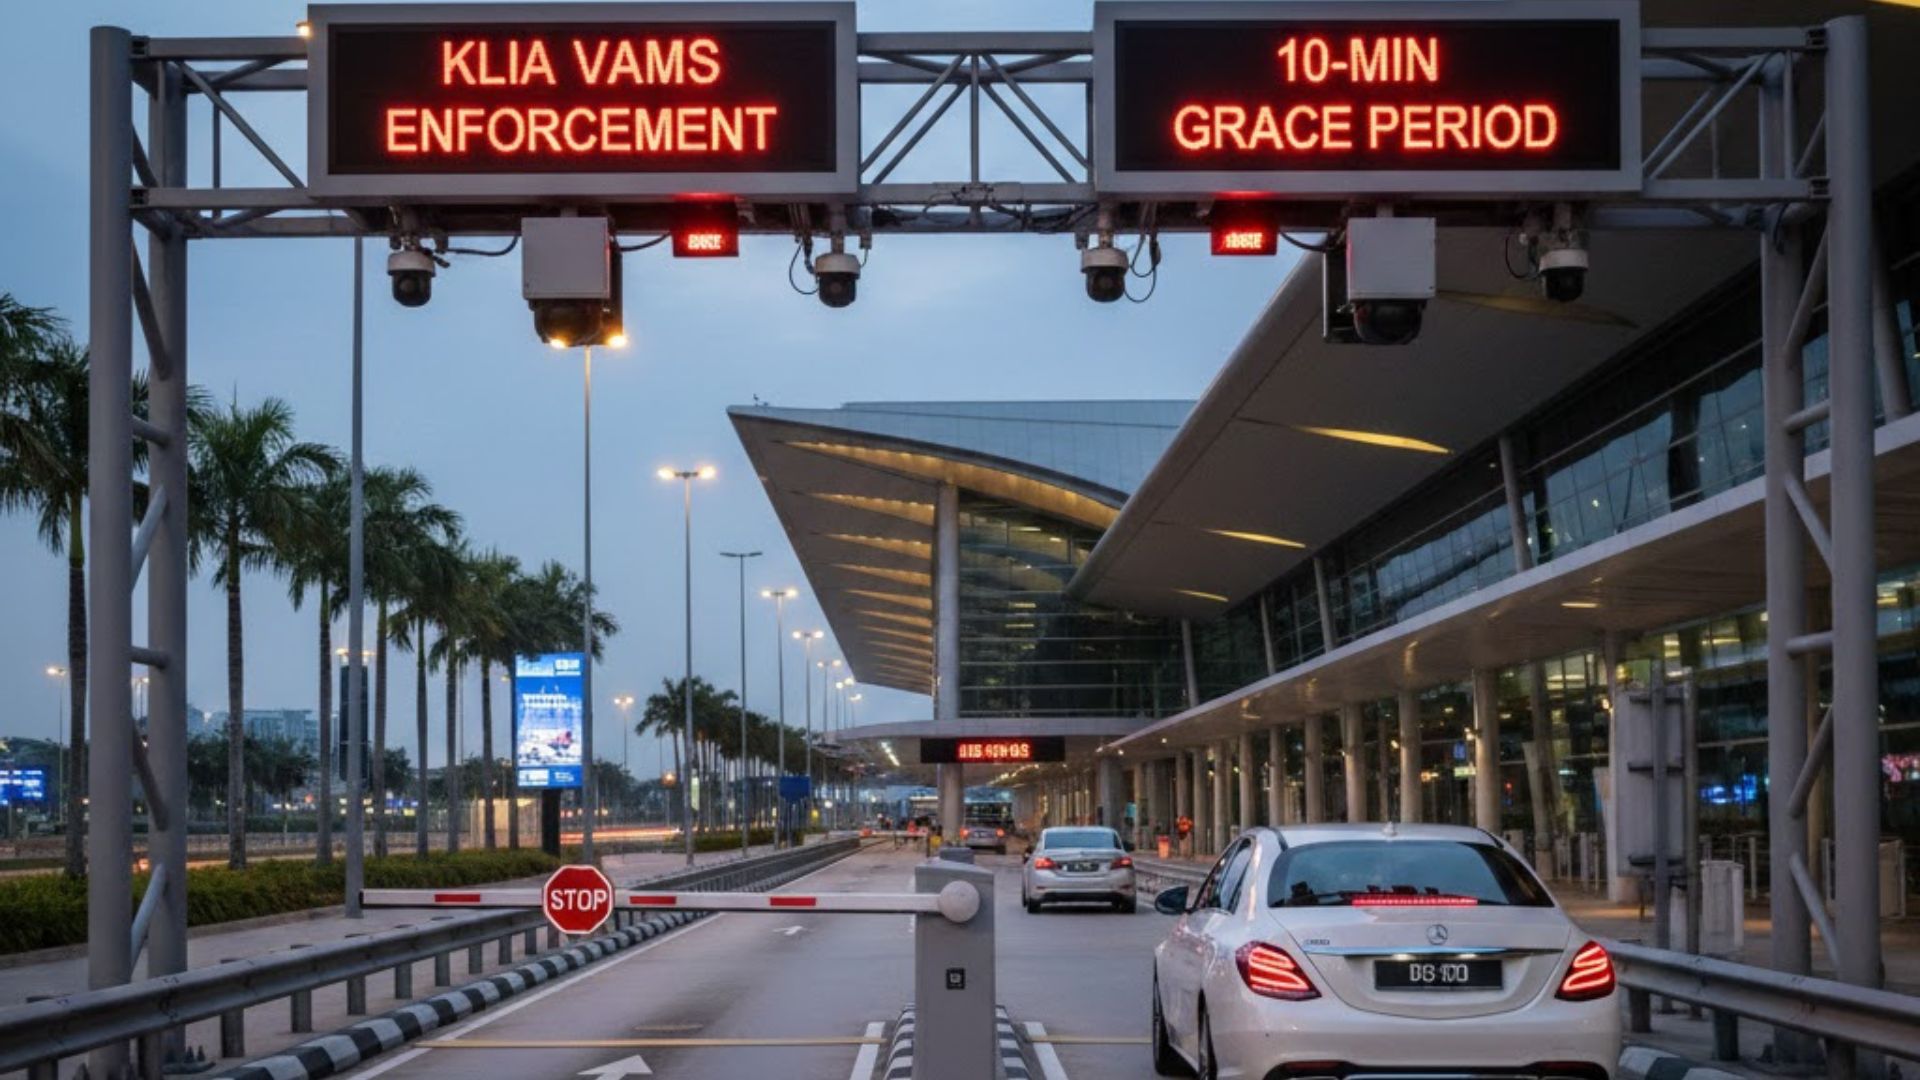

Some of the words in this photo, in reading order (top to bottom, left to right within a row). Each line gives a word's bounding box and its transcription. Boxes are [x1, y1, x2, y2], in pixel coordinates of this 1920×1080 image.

[442, 39, 556, 86] KLIA
[573, 38, 721, 85] VAMS
[1277, 36, 1438, 84] 10-MIN
[386, 106, 777, 153] ENFORCEMENT
[1174, 104, 1352, 151] GRACE
[1368, 104, 1557, 150] PERIOD
[550, 888, 607, 911] STOP
